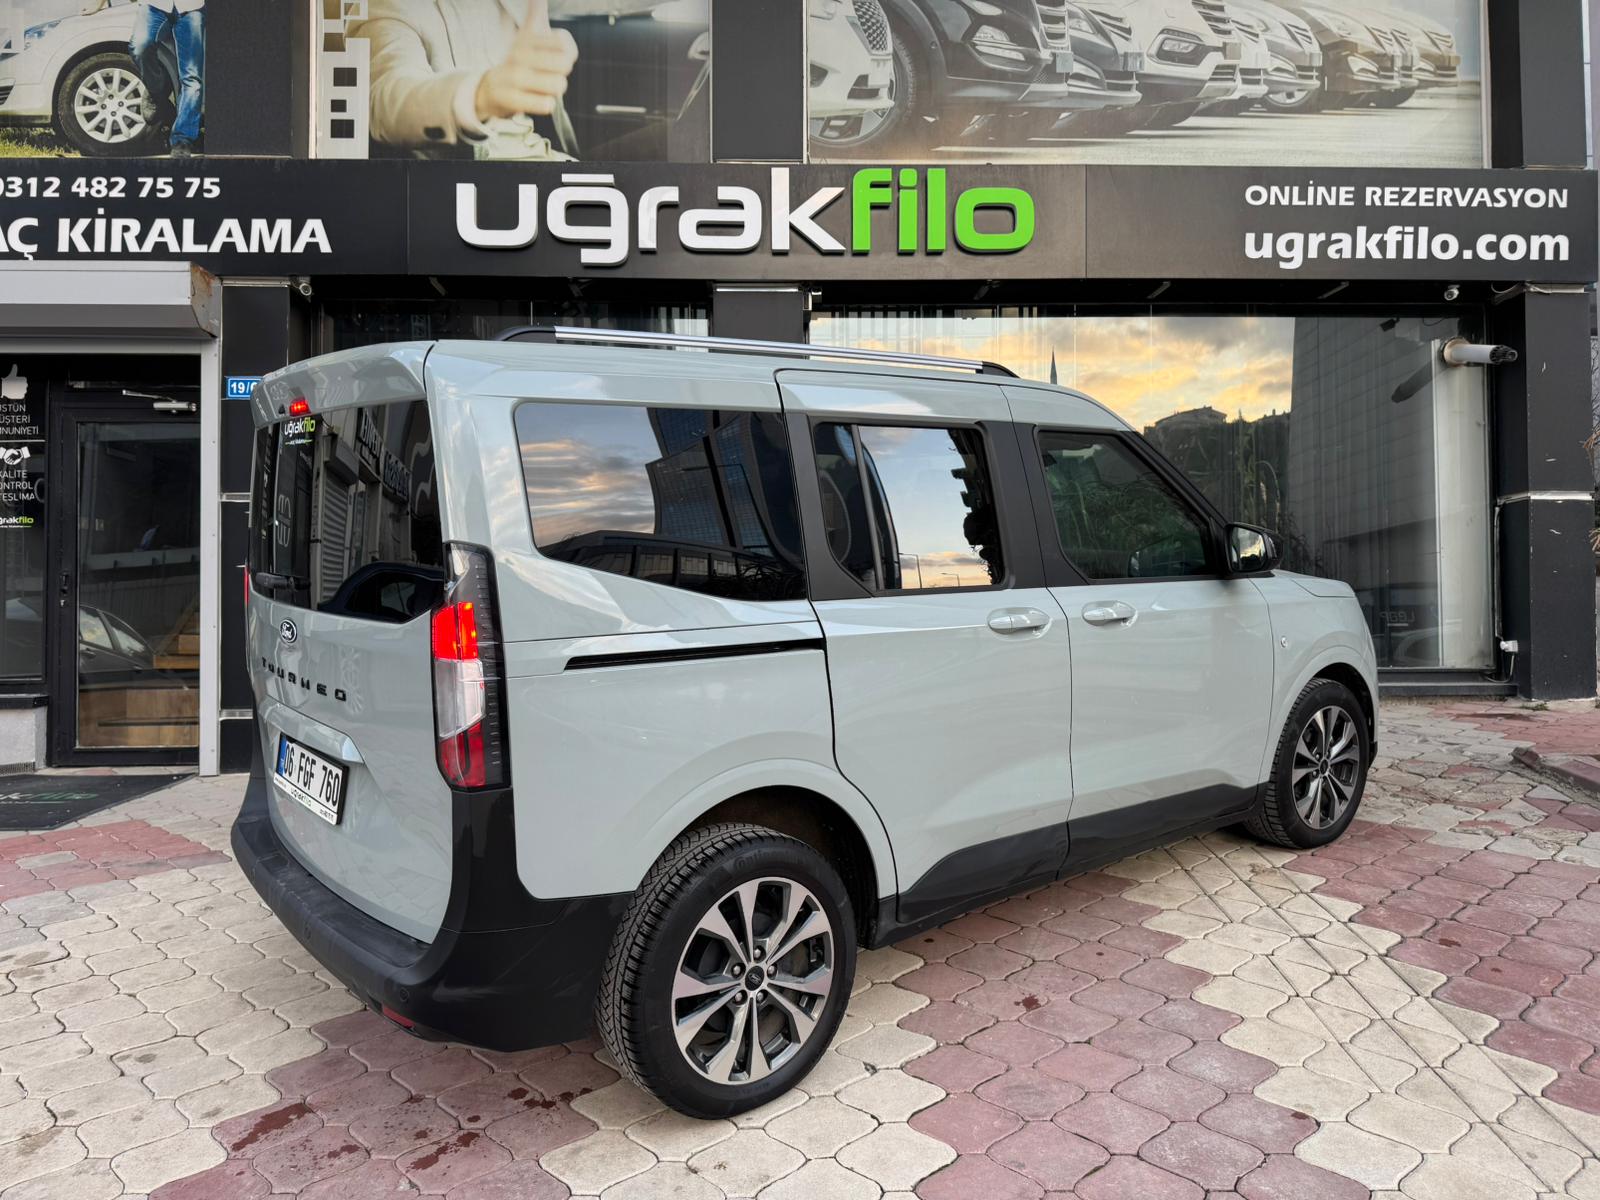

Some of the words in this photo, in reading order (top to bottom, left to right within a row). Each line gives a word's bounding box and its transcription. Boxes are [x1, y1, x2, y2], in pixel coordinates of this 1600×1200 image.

[0, 176, 61, 198] 312
[71, 176, 127, 198] 482
[137, 176, 174, 199] 75
[184, 176, 221, 199] 75
[1244, 180, 1355, 207] ONLİNE
[1365, 185, 1568, 209] REZERVASYON
[0, 216, 39, 260] Ç
[57, 207, 333, 253] KİRALAMA
[1244, 225, 1570, 270] ugrakfilo.com
[0, 402, 26, 412] STÜN
[283, 743, 295, 778] 06
[297, 752, 317, 791] FGF
[319, 764, 340, 807] 760
